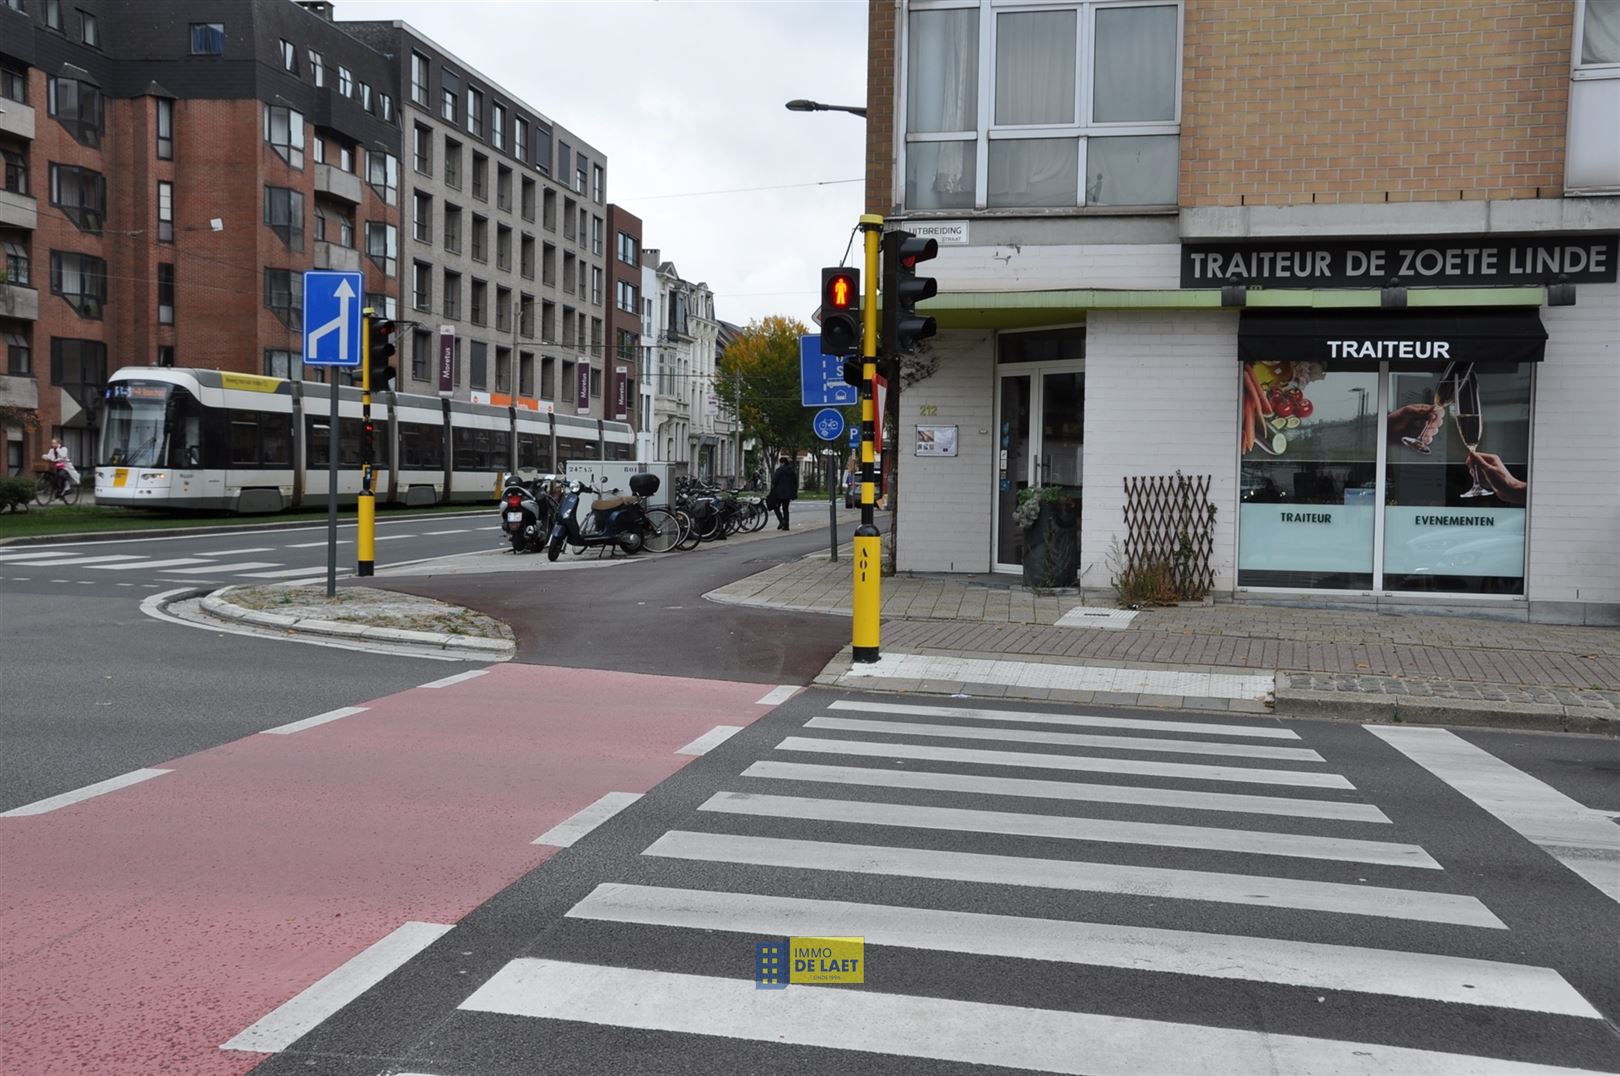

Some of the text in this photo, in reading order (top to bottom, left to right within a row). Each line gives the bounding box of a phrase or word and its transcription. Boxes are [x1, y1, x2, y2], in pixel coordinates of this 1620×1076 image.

[908, 226, 962, 235] UITBREIDING
[1190, 245, 1607, 279] TRAITEUR DE ZOETE LINDE
[1326, 340, 1451, 359] TRAITEUR
[442, 347, 451, 379] Moretus
[920, 405, 938, 417] 212
[850, 428, 859, 440] P
[1280, 512, 1332, 523] TRAITEUR
[1415, 515, 1495, 527] EVENEMENTEN
